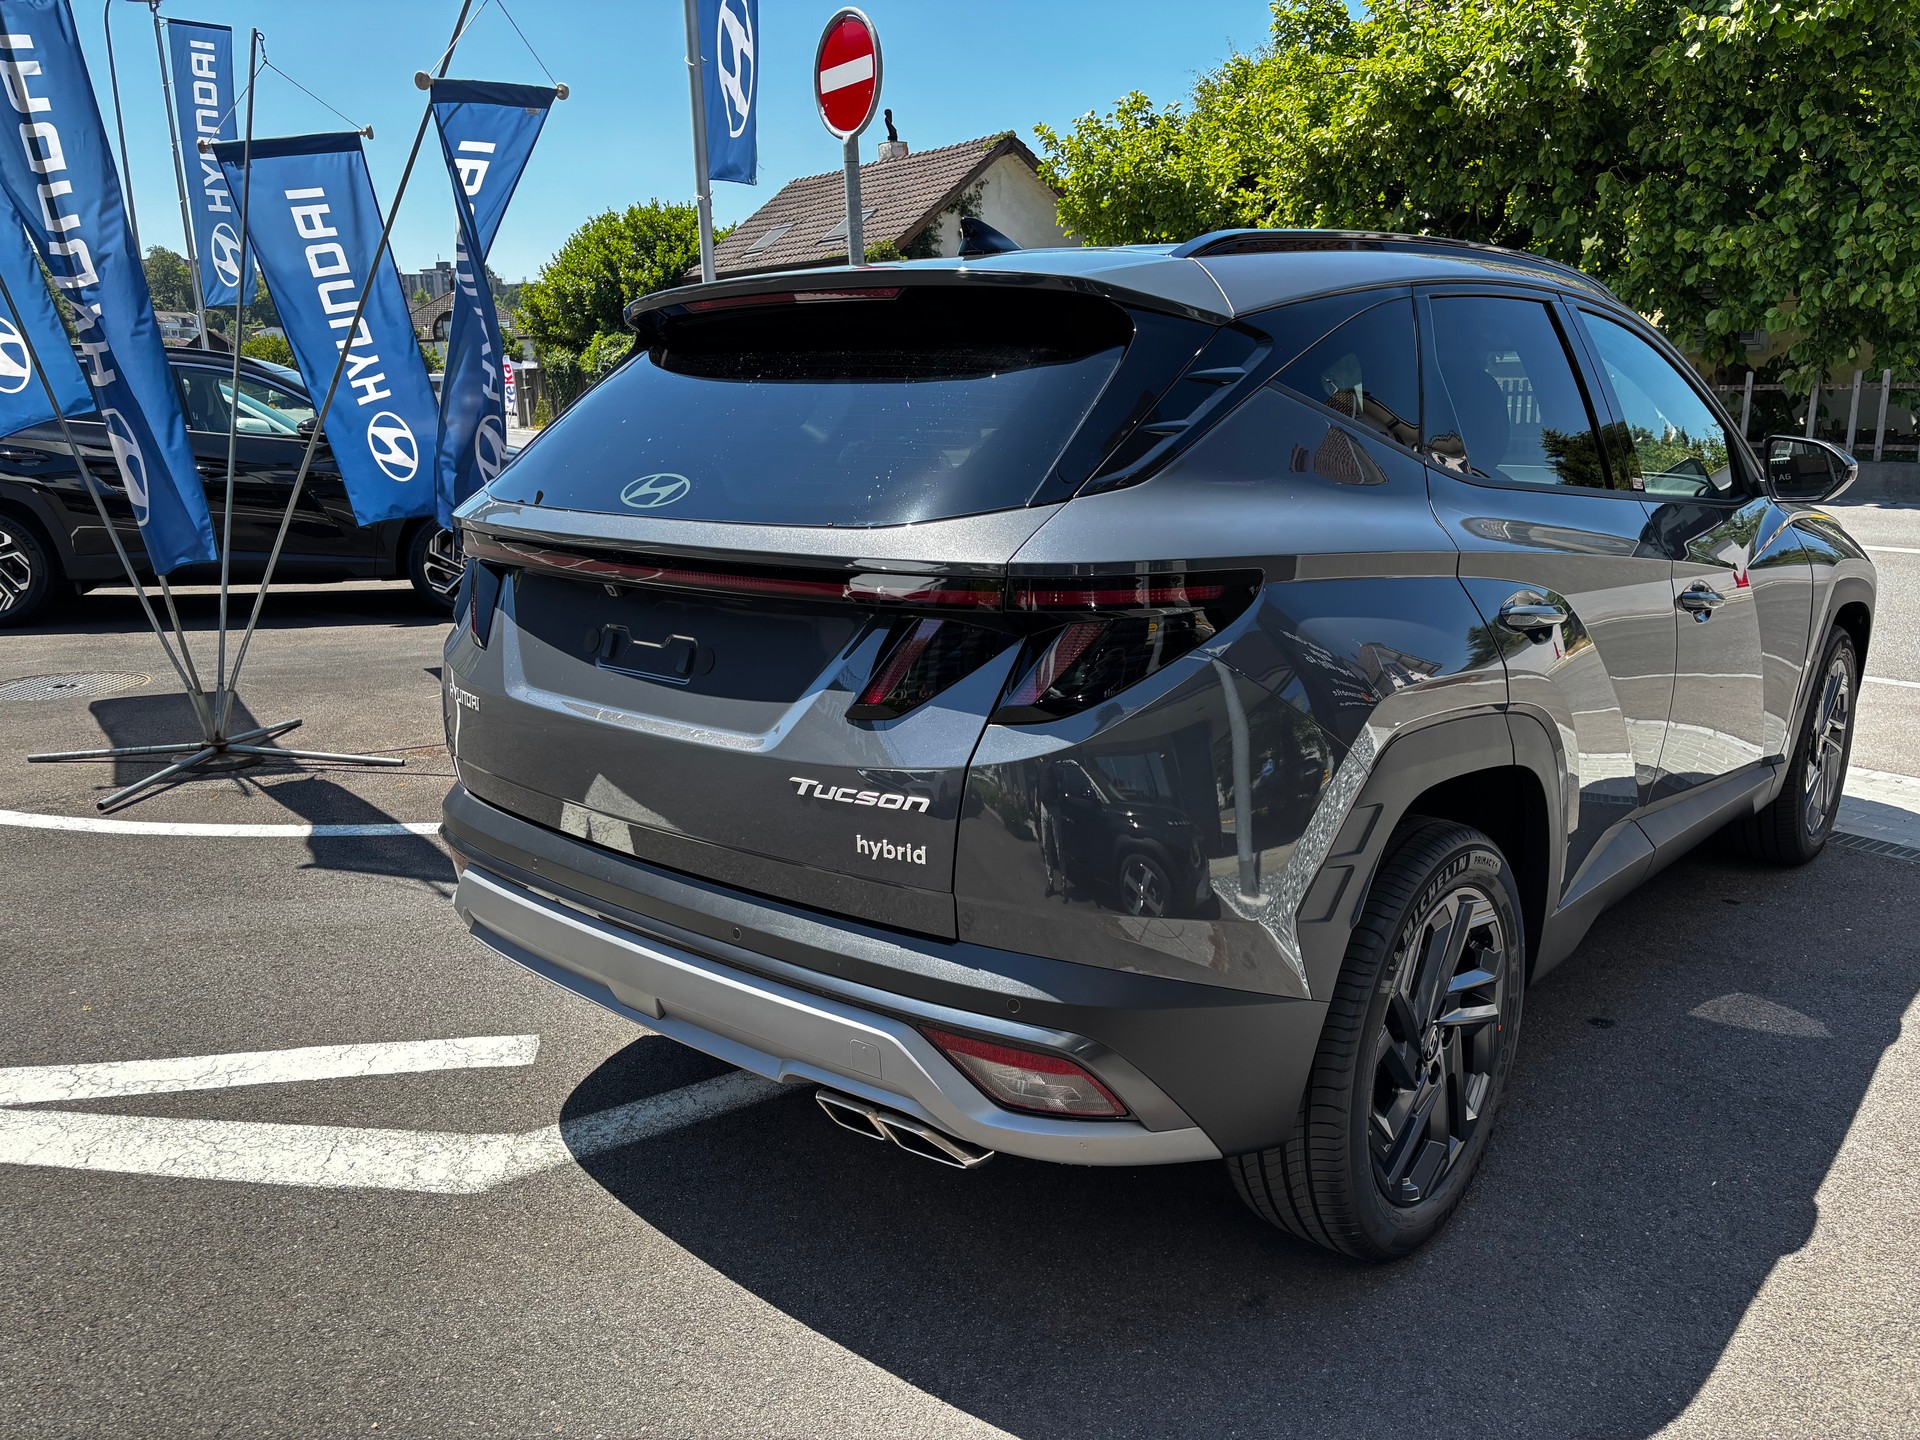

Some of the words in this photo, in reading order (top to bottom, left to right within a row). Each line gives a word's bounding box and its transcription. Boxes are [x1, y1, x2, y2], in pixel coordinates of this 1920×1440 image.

[284, 187, 392, 406] HYUNDAI
[449, 682, 480, 712] HYUNDAI
[855, 834, 927, 865] hybrid
[1401, 855, 1468, 946] MICHELIN
